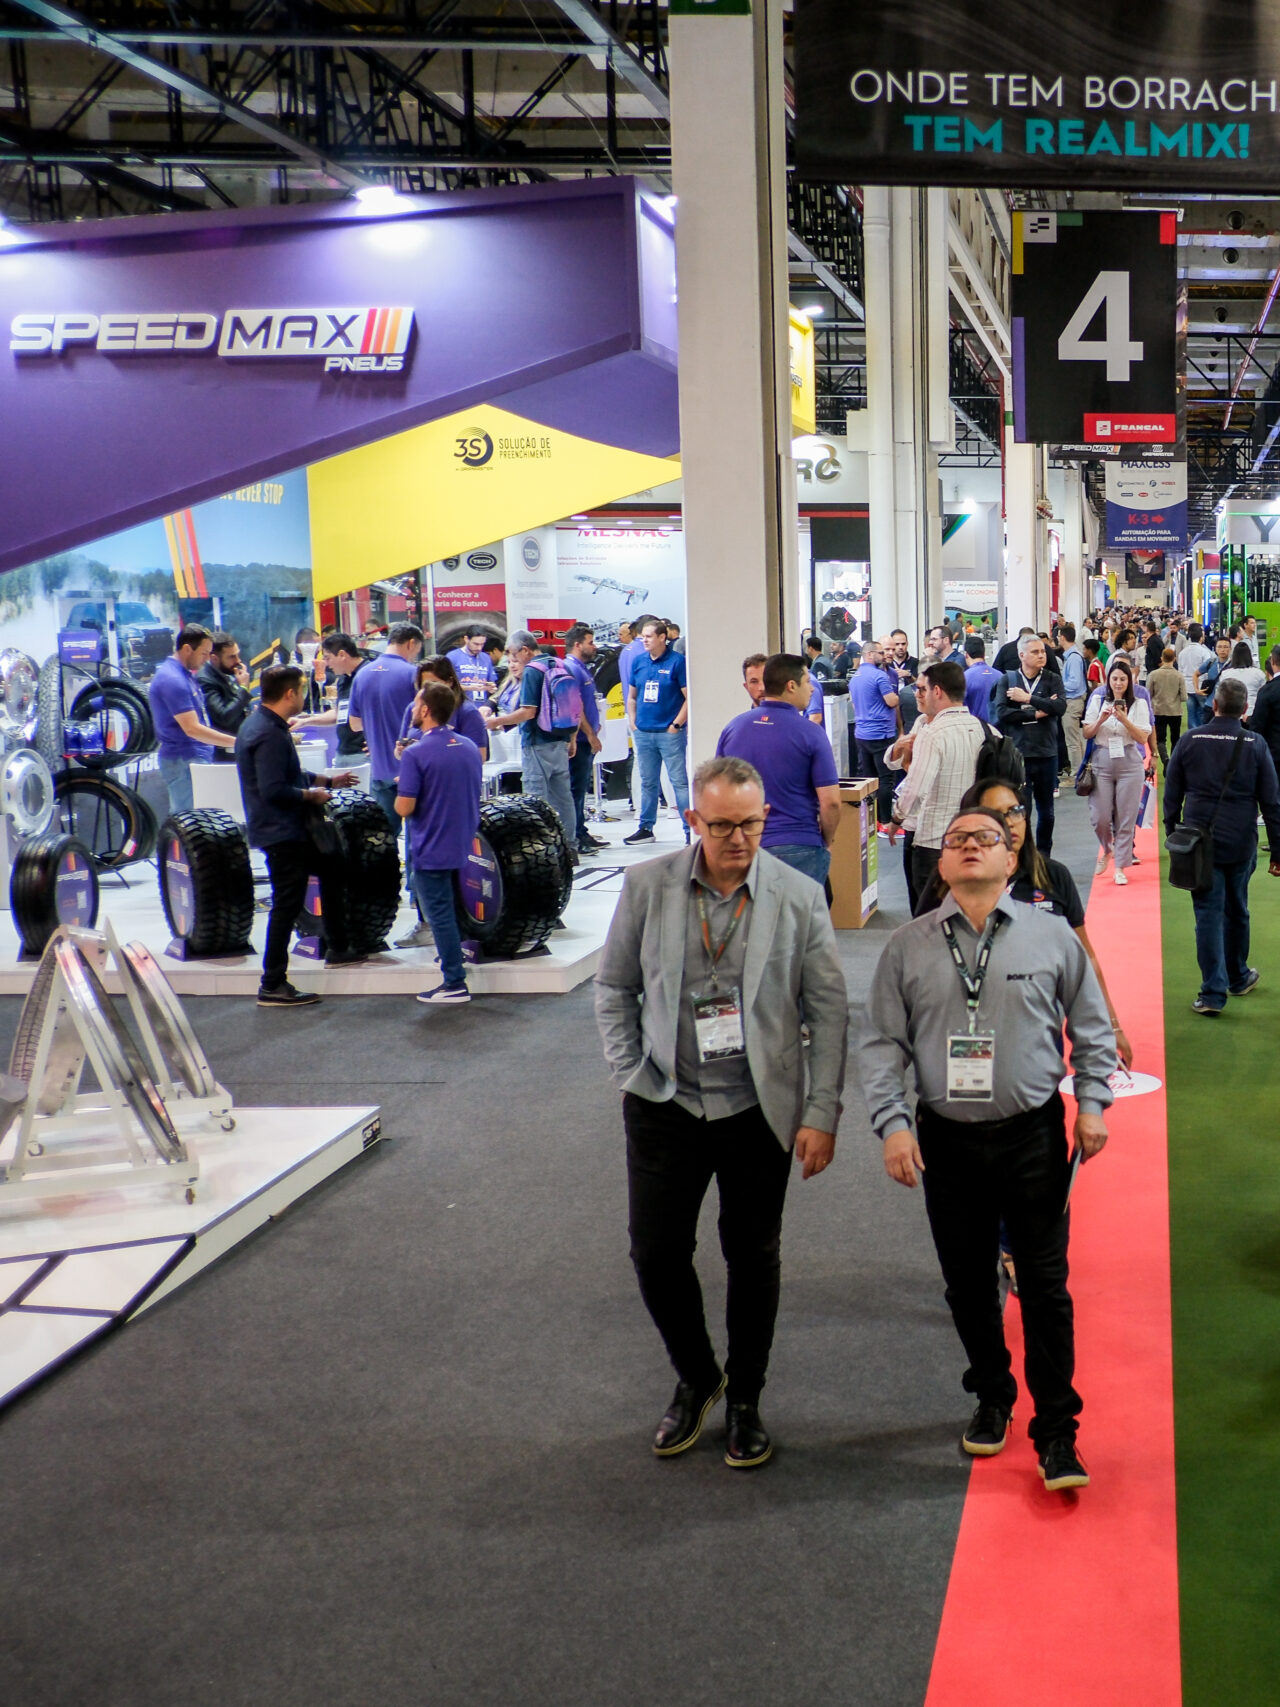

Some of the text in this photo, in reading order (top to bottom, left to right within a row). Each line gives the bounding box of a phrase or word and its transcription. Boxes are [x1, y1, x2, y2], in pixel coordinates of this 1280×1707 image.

[850, 70, 969, 105] ONDE
[984, 74, 1063, 107] TEM
[904, 115, 1250, 159] TEM REALMIX!
[1058, 271, 1144, 381] 4
[324, 356, 404, 372] PNEUS
[540, 437, 551, 449] DE
[499, 450, 552, 459] PREENCHIMENTO
[264, 483, 284, 505] STOP
[1128, 514, 1149, 525] K-3
[437, 591, 473, 599] Conhecer
